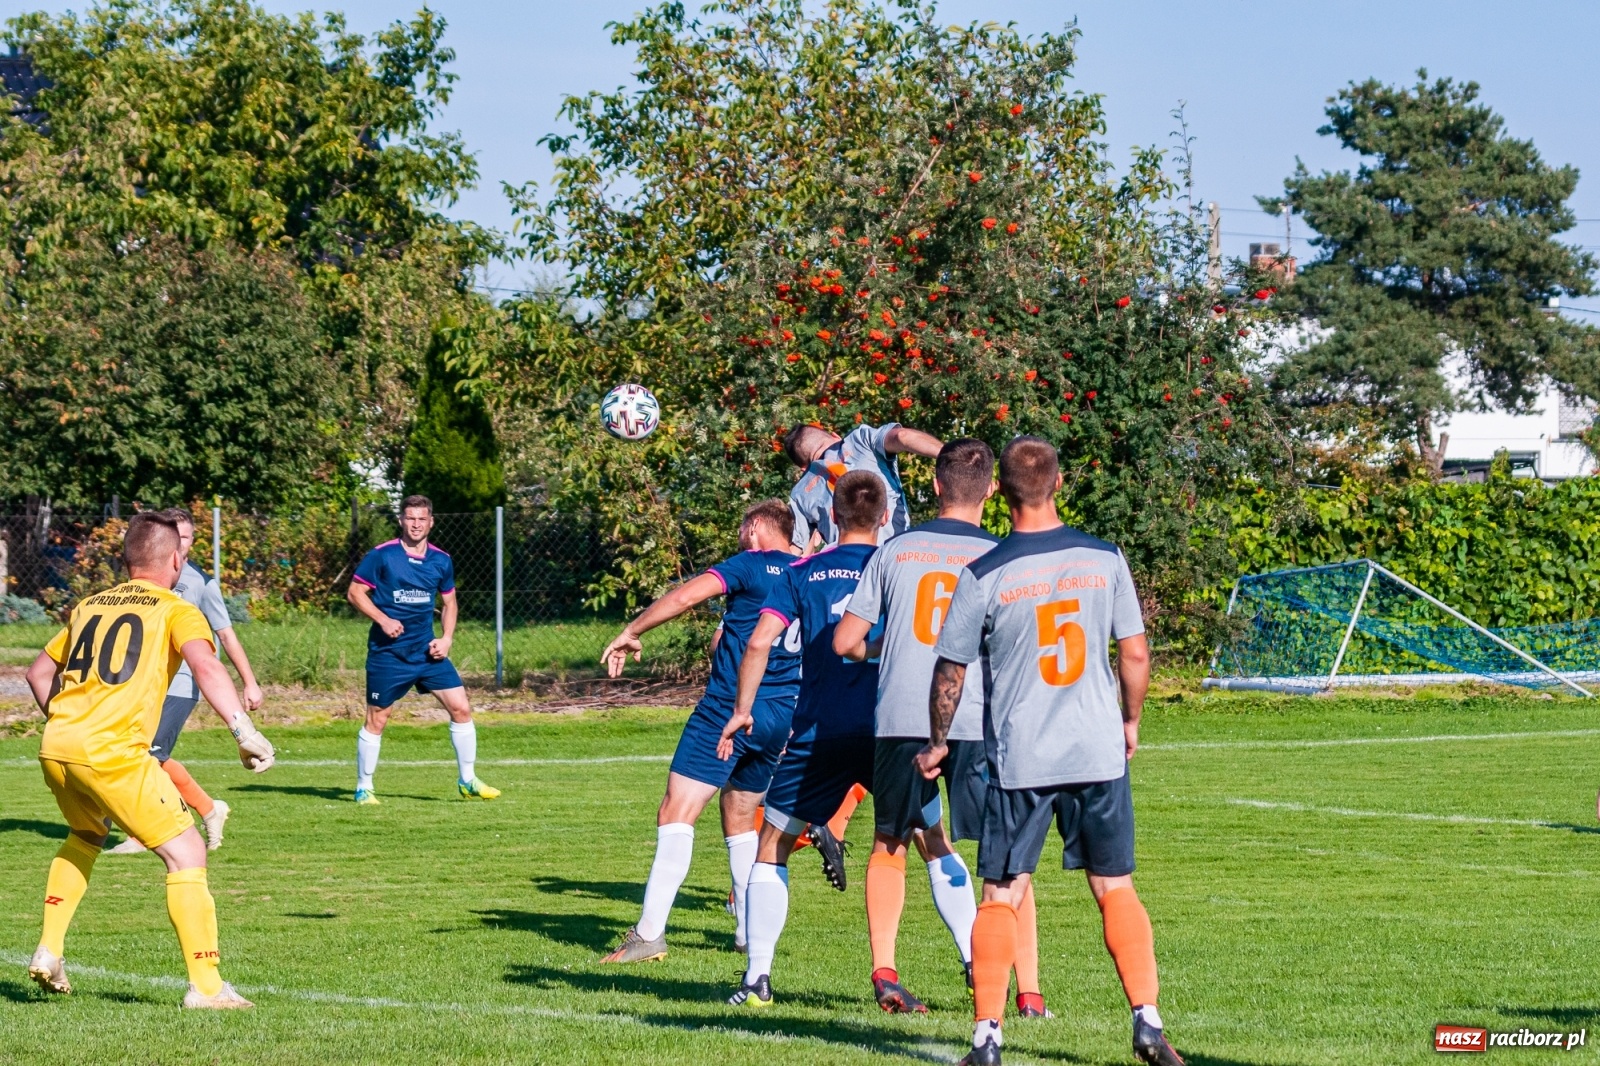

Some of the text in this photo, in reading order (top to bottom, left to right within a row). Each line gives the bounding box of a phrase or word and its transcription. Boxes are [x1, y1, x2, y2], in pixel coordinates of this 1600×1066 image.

[766, 564, 781, 576] LKS
[946, 554, 977, 566] BORU
[1056, 574, 1107, 592] BORUCIN
[913, 571, 960, 647] 6
[67, 613, 144, 685] 40
[1035, 598, 1087, 687] 5
